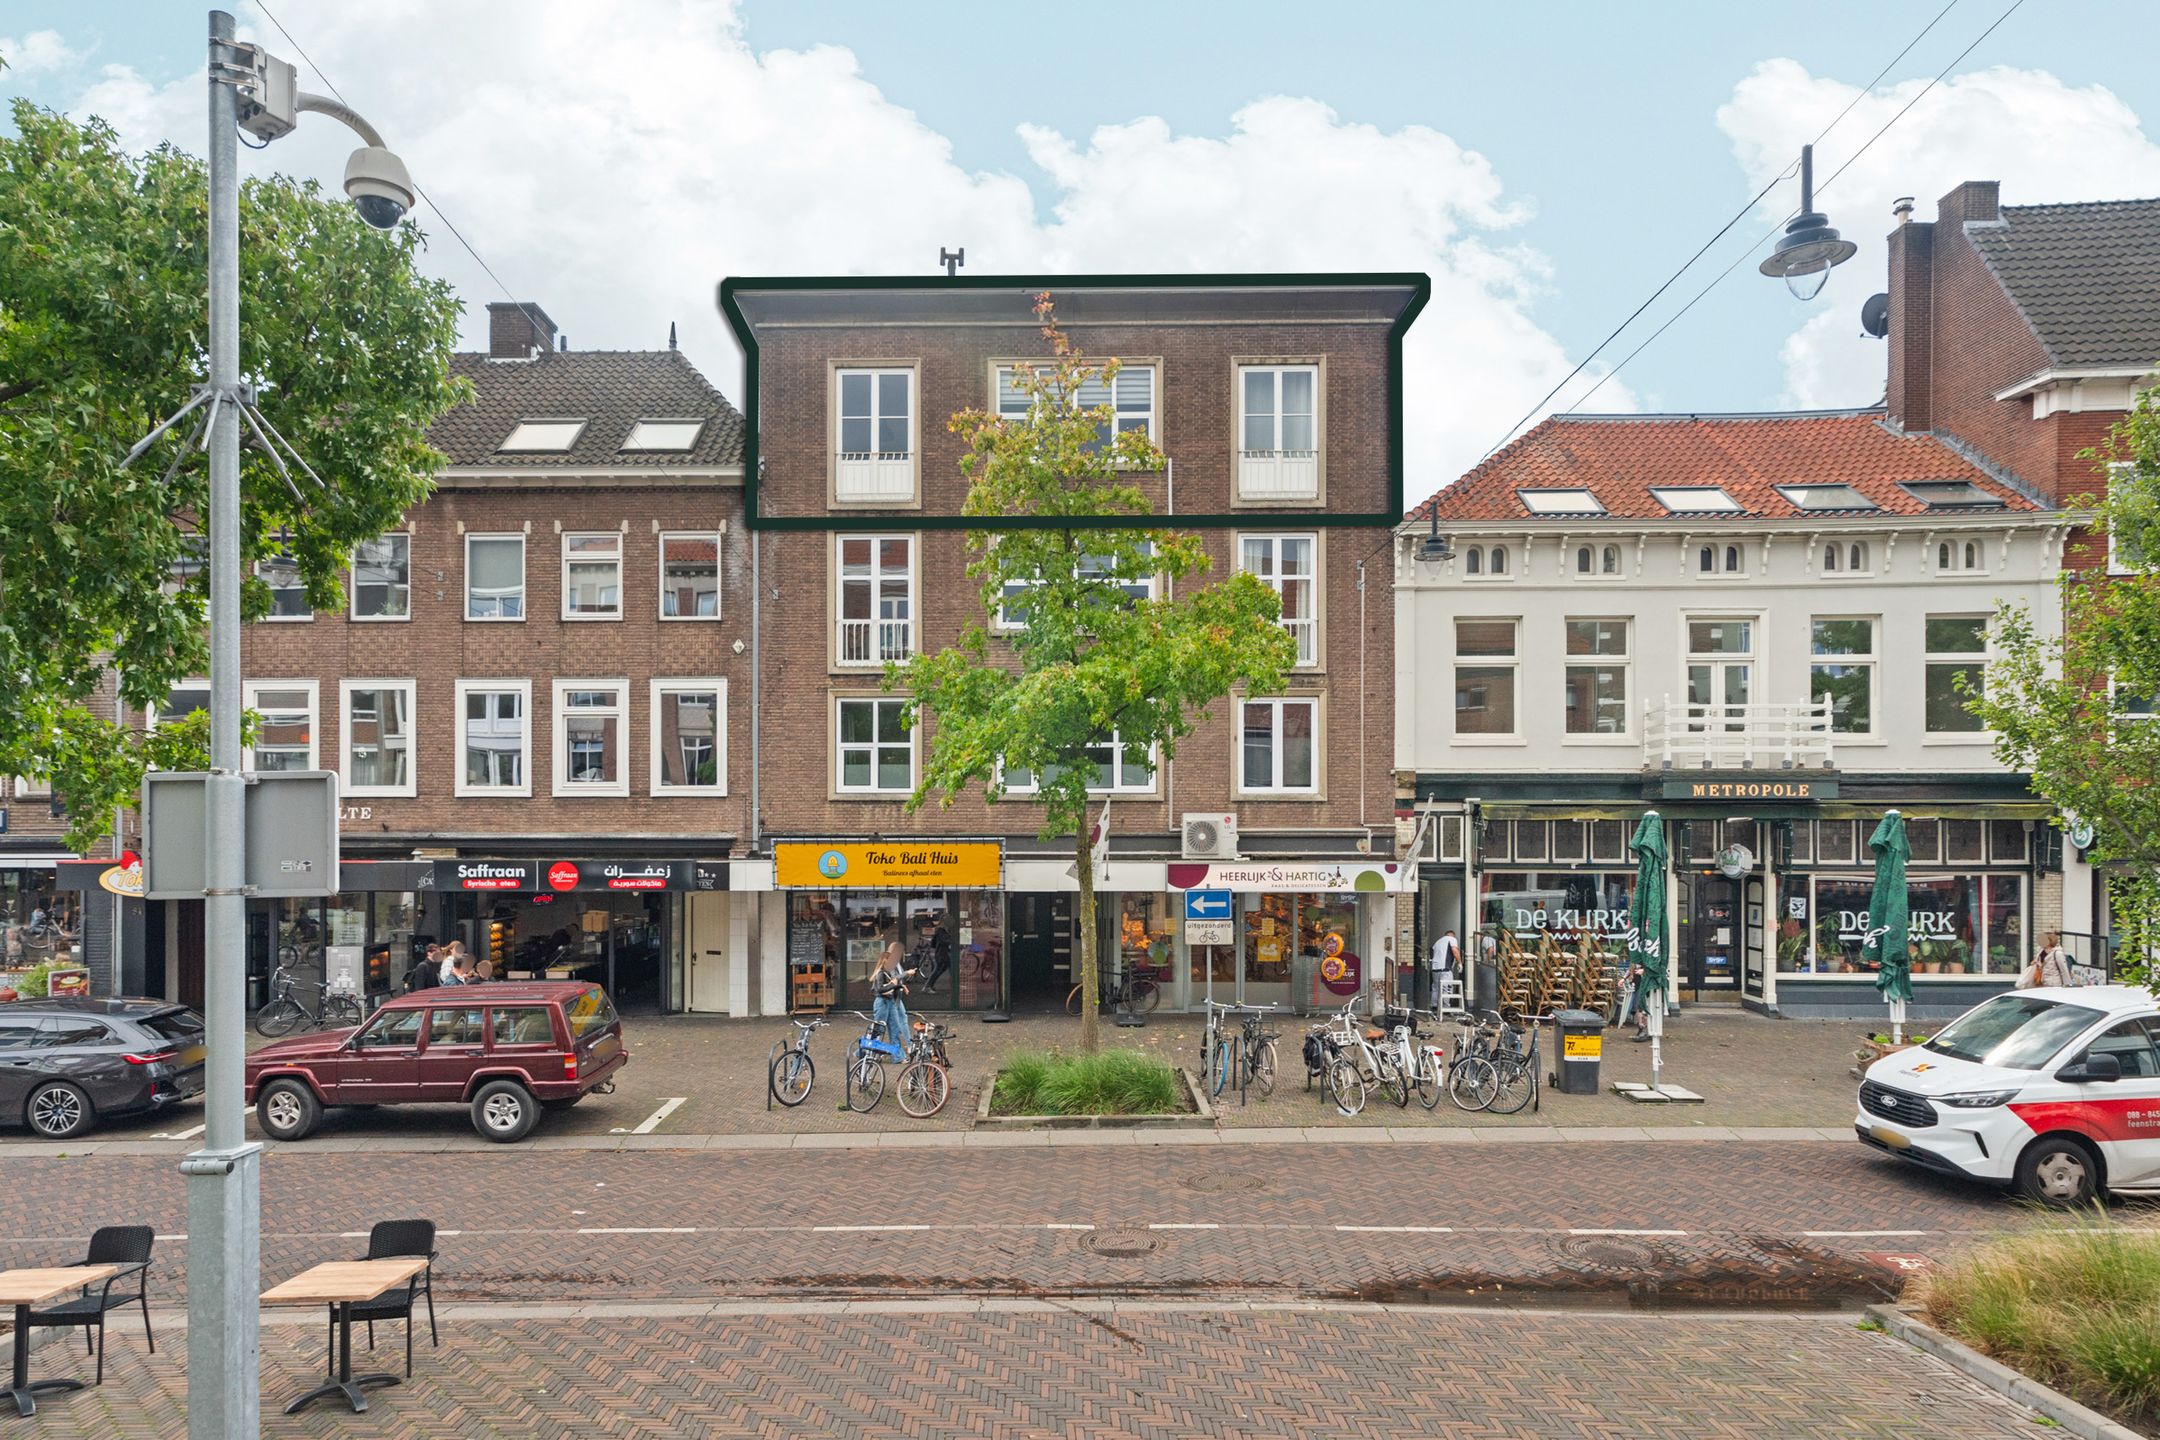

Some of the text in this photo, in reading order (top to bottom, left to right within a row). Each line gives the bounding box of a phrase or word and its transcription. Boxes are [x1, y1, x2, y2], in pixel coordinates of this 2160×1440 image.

[1692, 784, 1809, 797] METROPOLE
[339, 807, 371, 819] LTE
[866, 851, 958, 864] Toko Bali Huis
[458, 864, 525, 878] Saffraan
[604, 865, 671, 878] زعفران
[1220, 867, 1326, 883] HEERLIJK & HARTIG
[467, 880, 496, 888] Syrische
[1554, 909, 1629, 930] KURK
